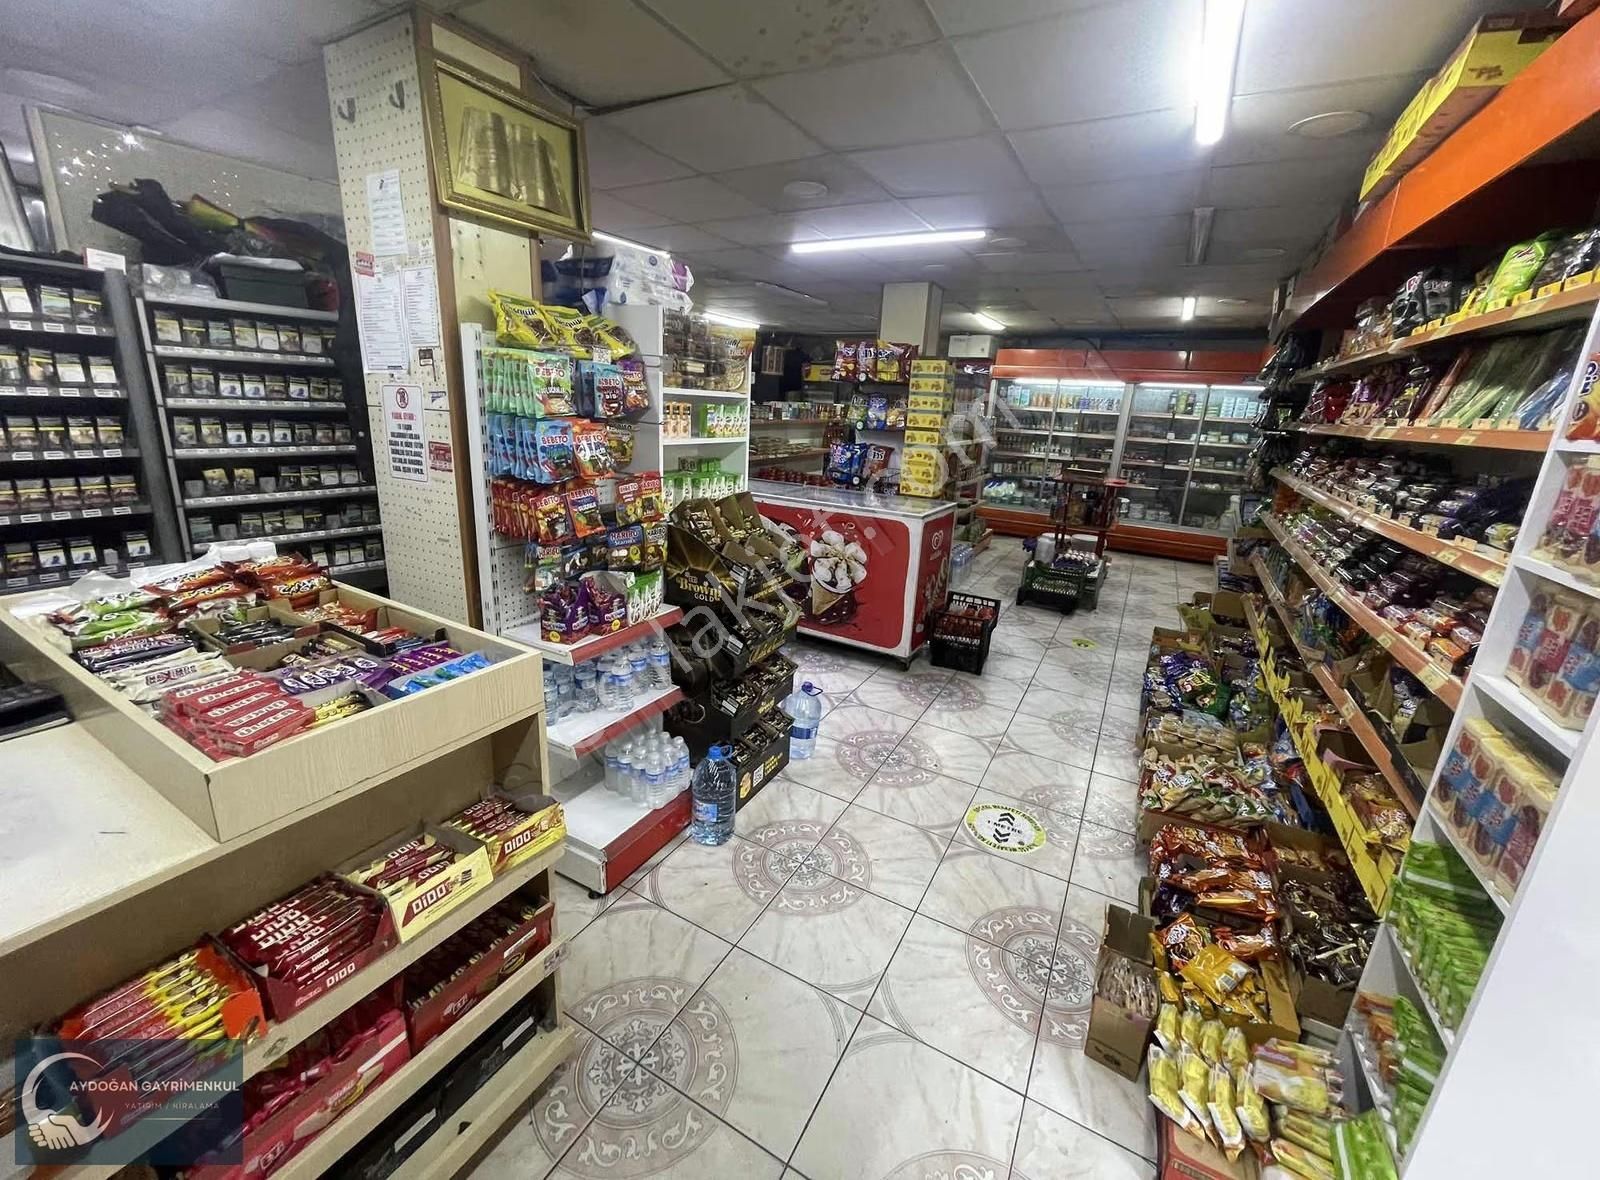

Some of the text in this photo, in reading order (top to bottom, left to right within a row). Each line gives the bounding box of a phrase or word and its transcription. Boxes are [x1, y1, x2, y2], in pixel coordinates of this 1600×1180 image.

[541, 435, 568, 445] BEBETO
[570, 488, 596, 500] BEBETO
[694, 593, 715, 603] GOLD
[326, 962, 356, 988] DIDO
